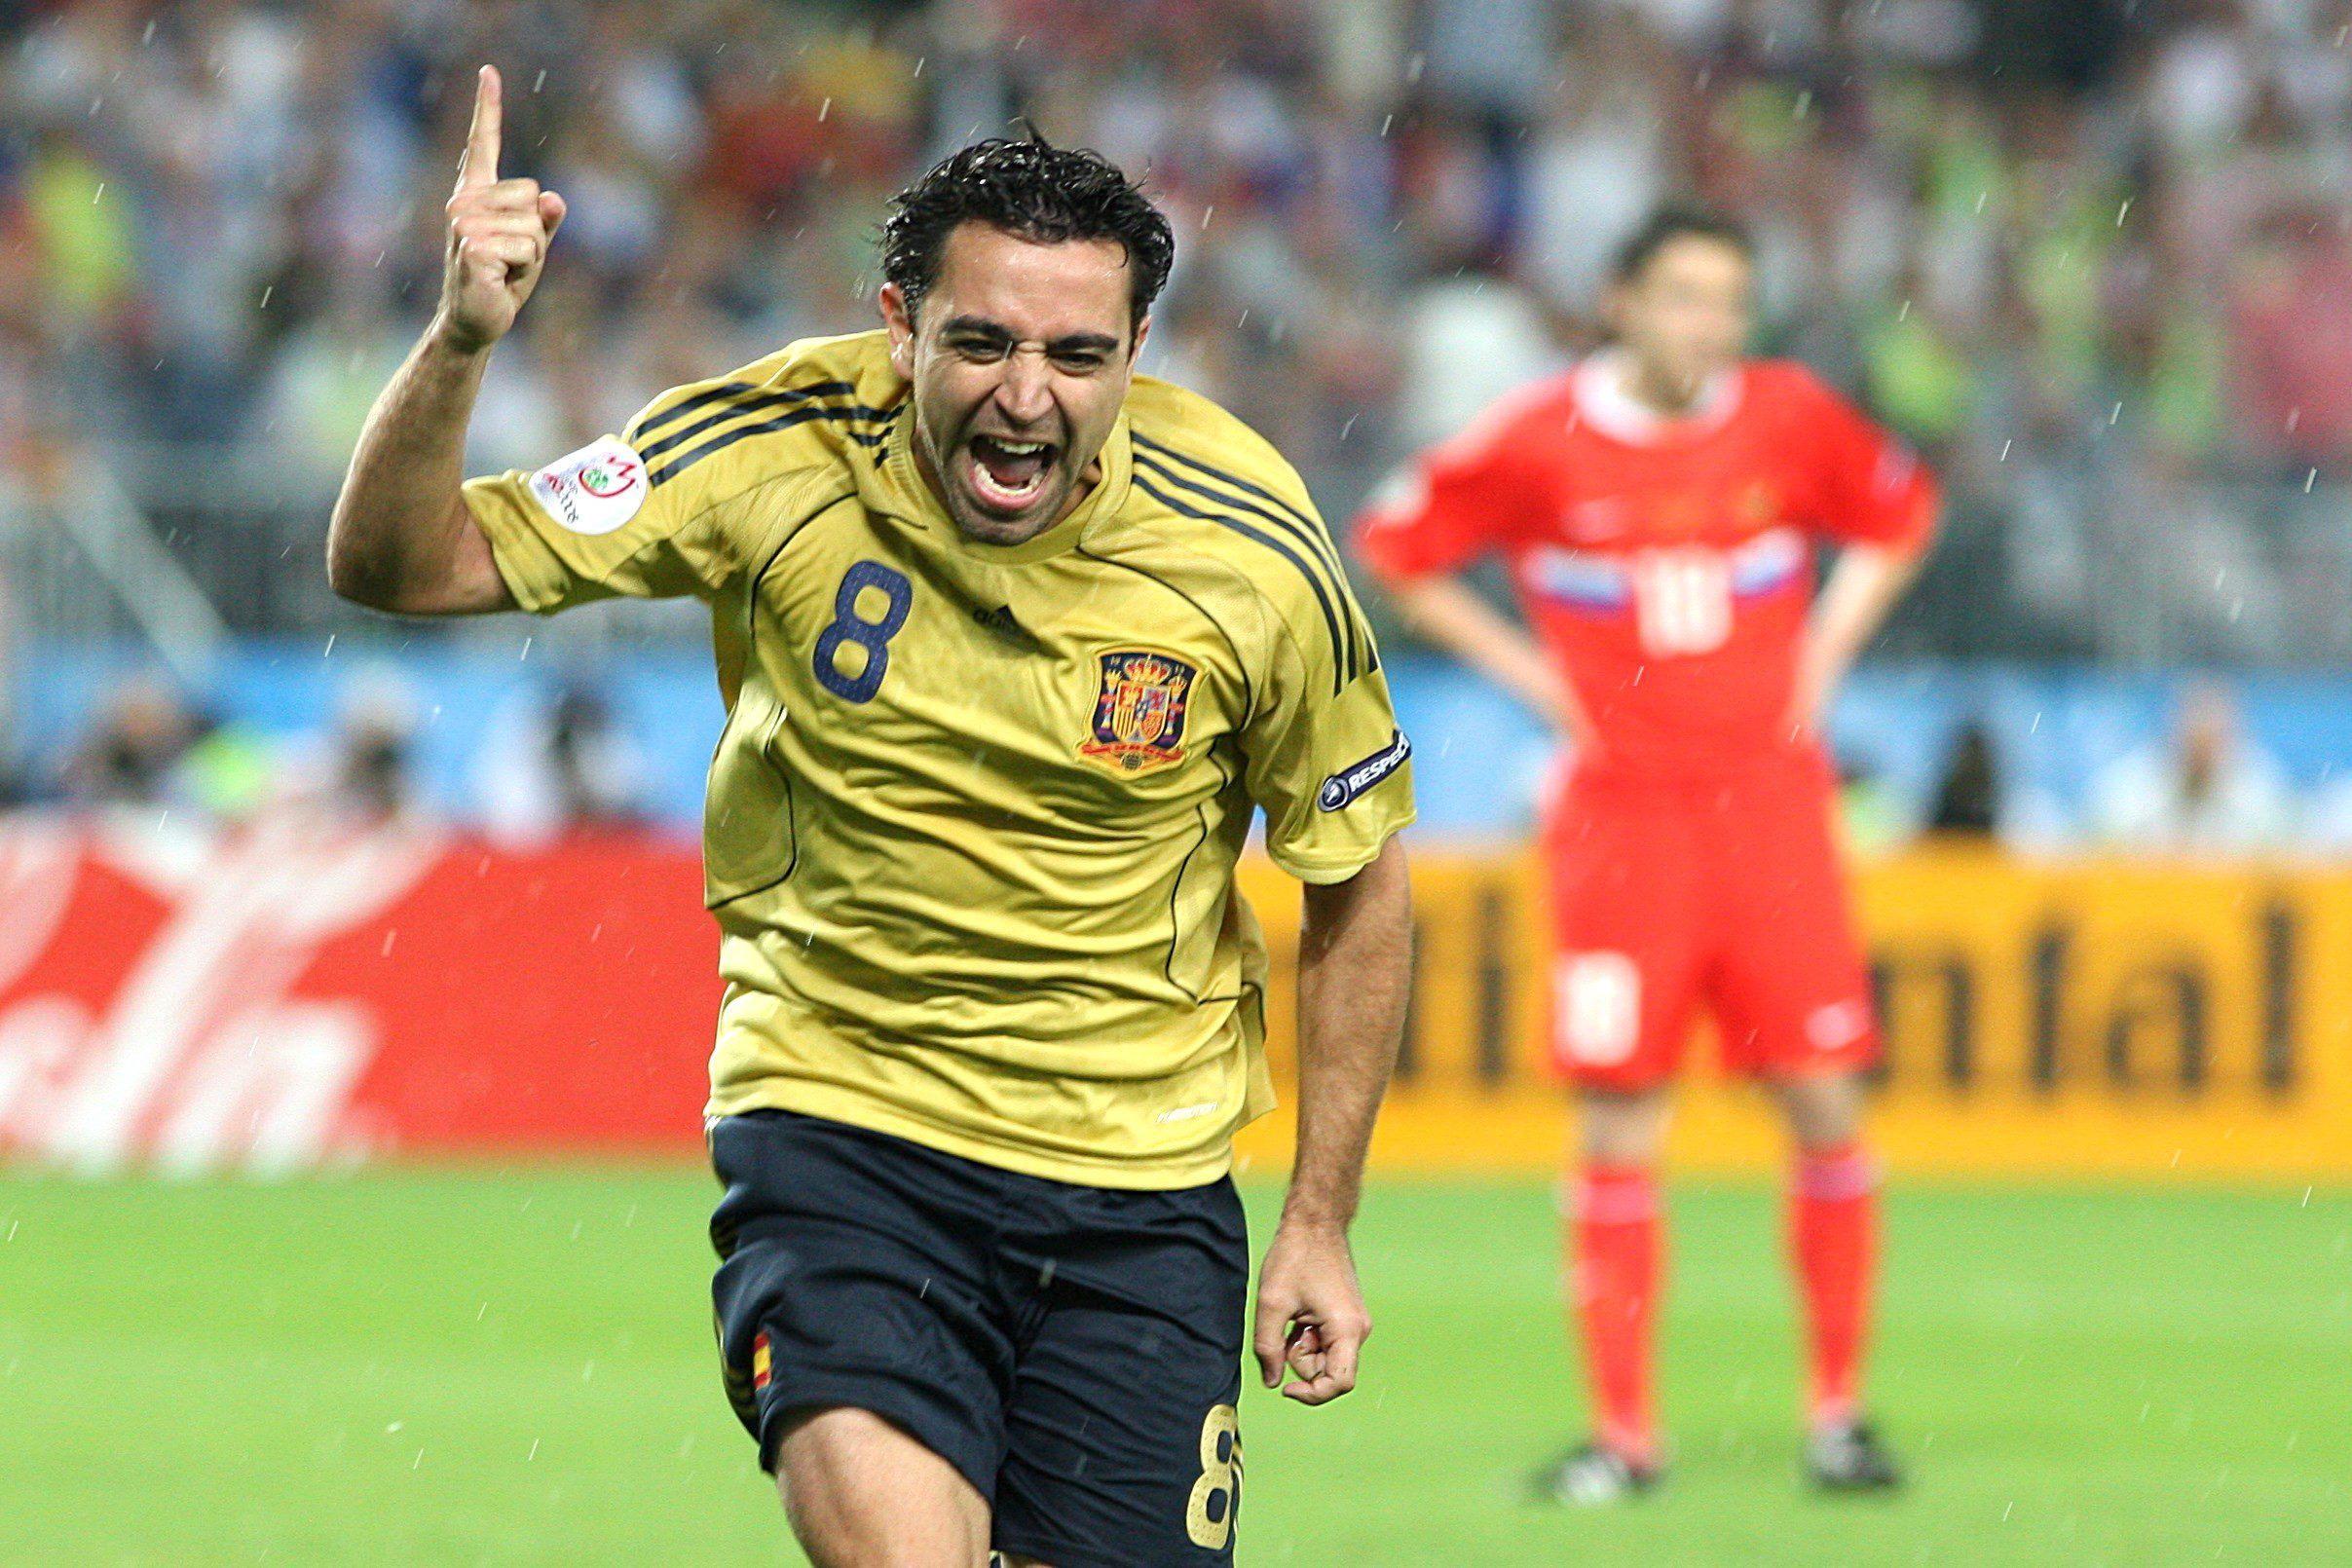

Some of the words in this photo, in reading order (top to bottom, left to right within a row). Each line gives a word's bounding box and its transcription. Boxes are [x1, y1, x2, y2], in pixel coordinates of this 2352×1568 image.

[813, 560, 913, 704] 8
[1348, 730, 1411, 793] RESPEC
[1186, 1403, 1240, 1550] 8
